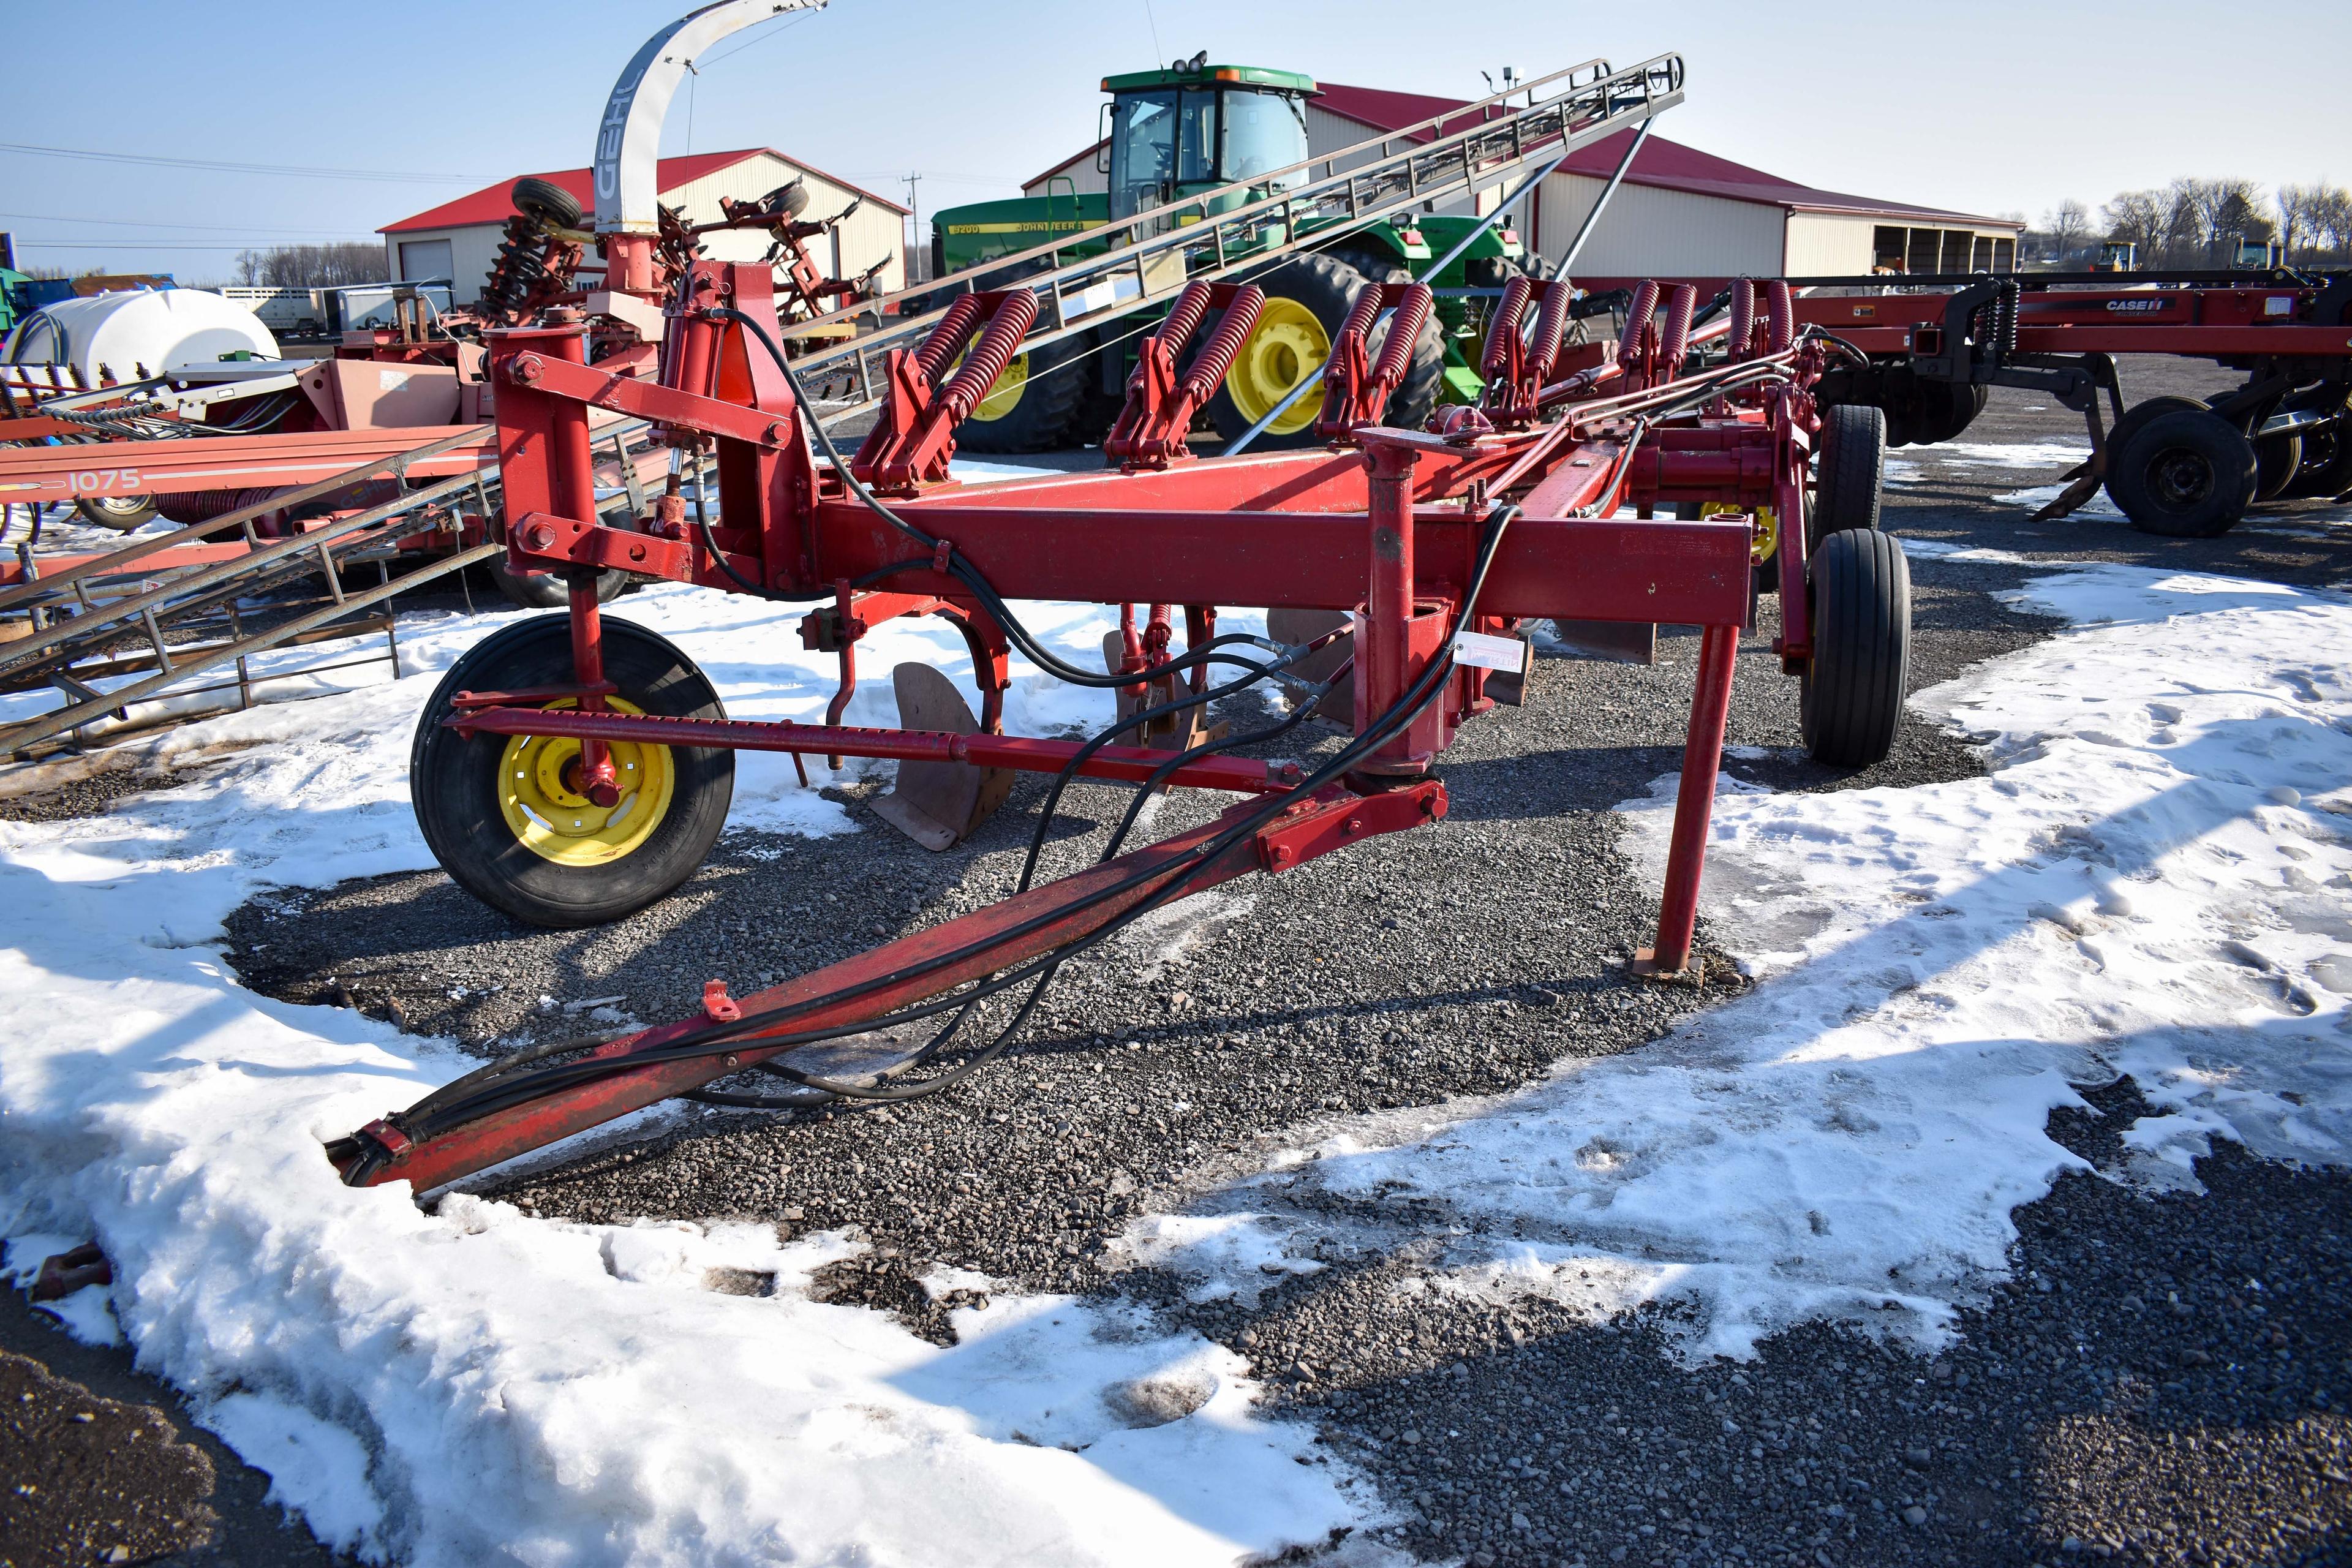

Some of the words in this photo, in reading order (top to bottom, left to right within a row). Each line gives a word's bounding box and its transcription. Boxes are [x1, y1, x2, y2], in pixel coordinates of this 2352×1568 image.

[598, 69, 644, 200] GEHL
[954, 224, 980, 233] 9200
[1017, 222, 1045, 232] JOHN
[2106, 300, 2147, 311] CASE
[70, 469, 141, 492] 1075
[341, 480, 392, 509] GEHL
